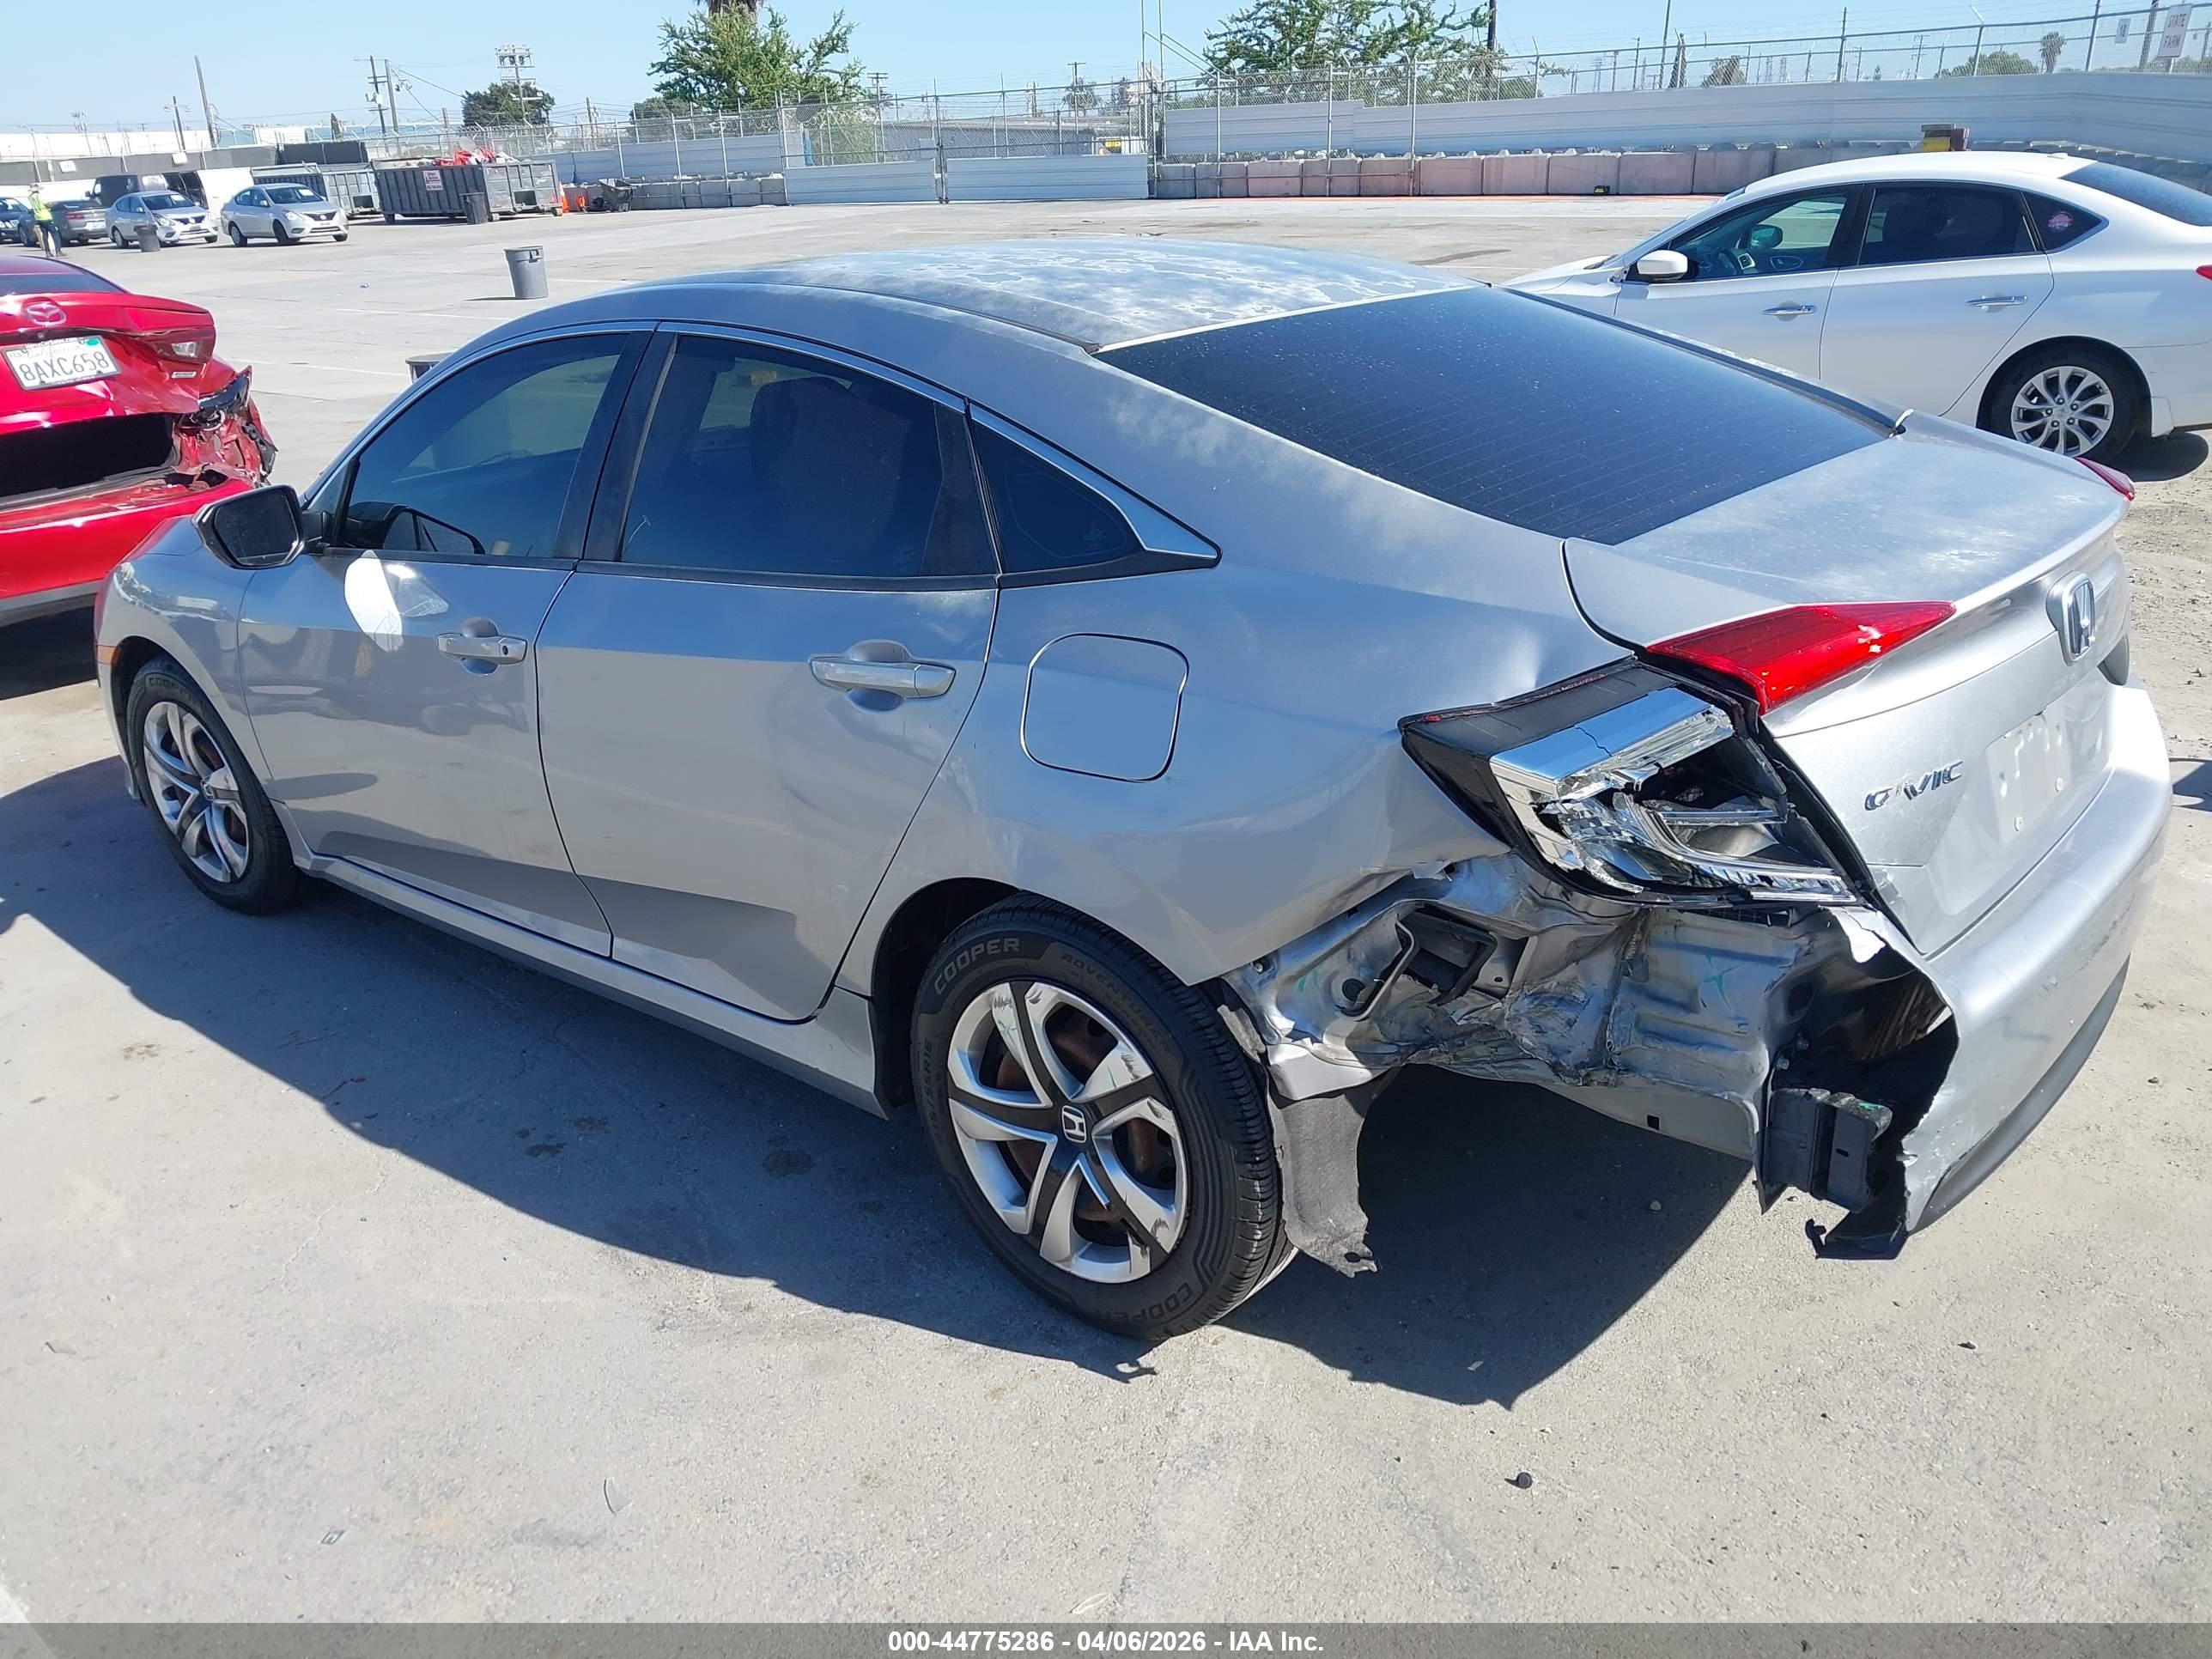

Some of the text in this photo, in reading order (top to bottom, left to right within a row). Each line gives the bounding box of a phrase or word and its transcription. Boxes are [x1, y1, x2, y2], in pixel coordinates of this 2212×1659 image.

[2167, 13, 2187, 28] STATE
[2164, 34, 2181, 49] FARM
[19, 351, 110, 381] 8AXC658
[1864, 760, 1964, 811] CIVIC
[933, 938, 1021, 995] COOPER
